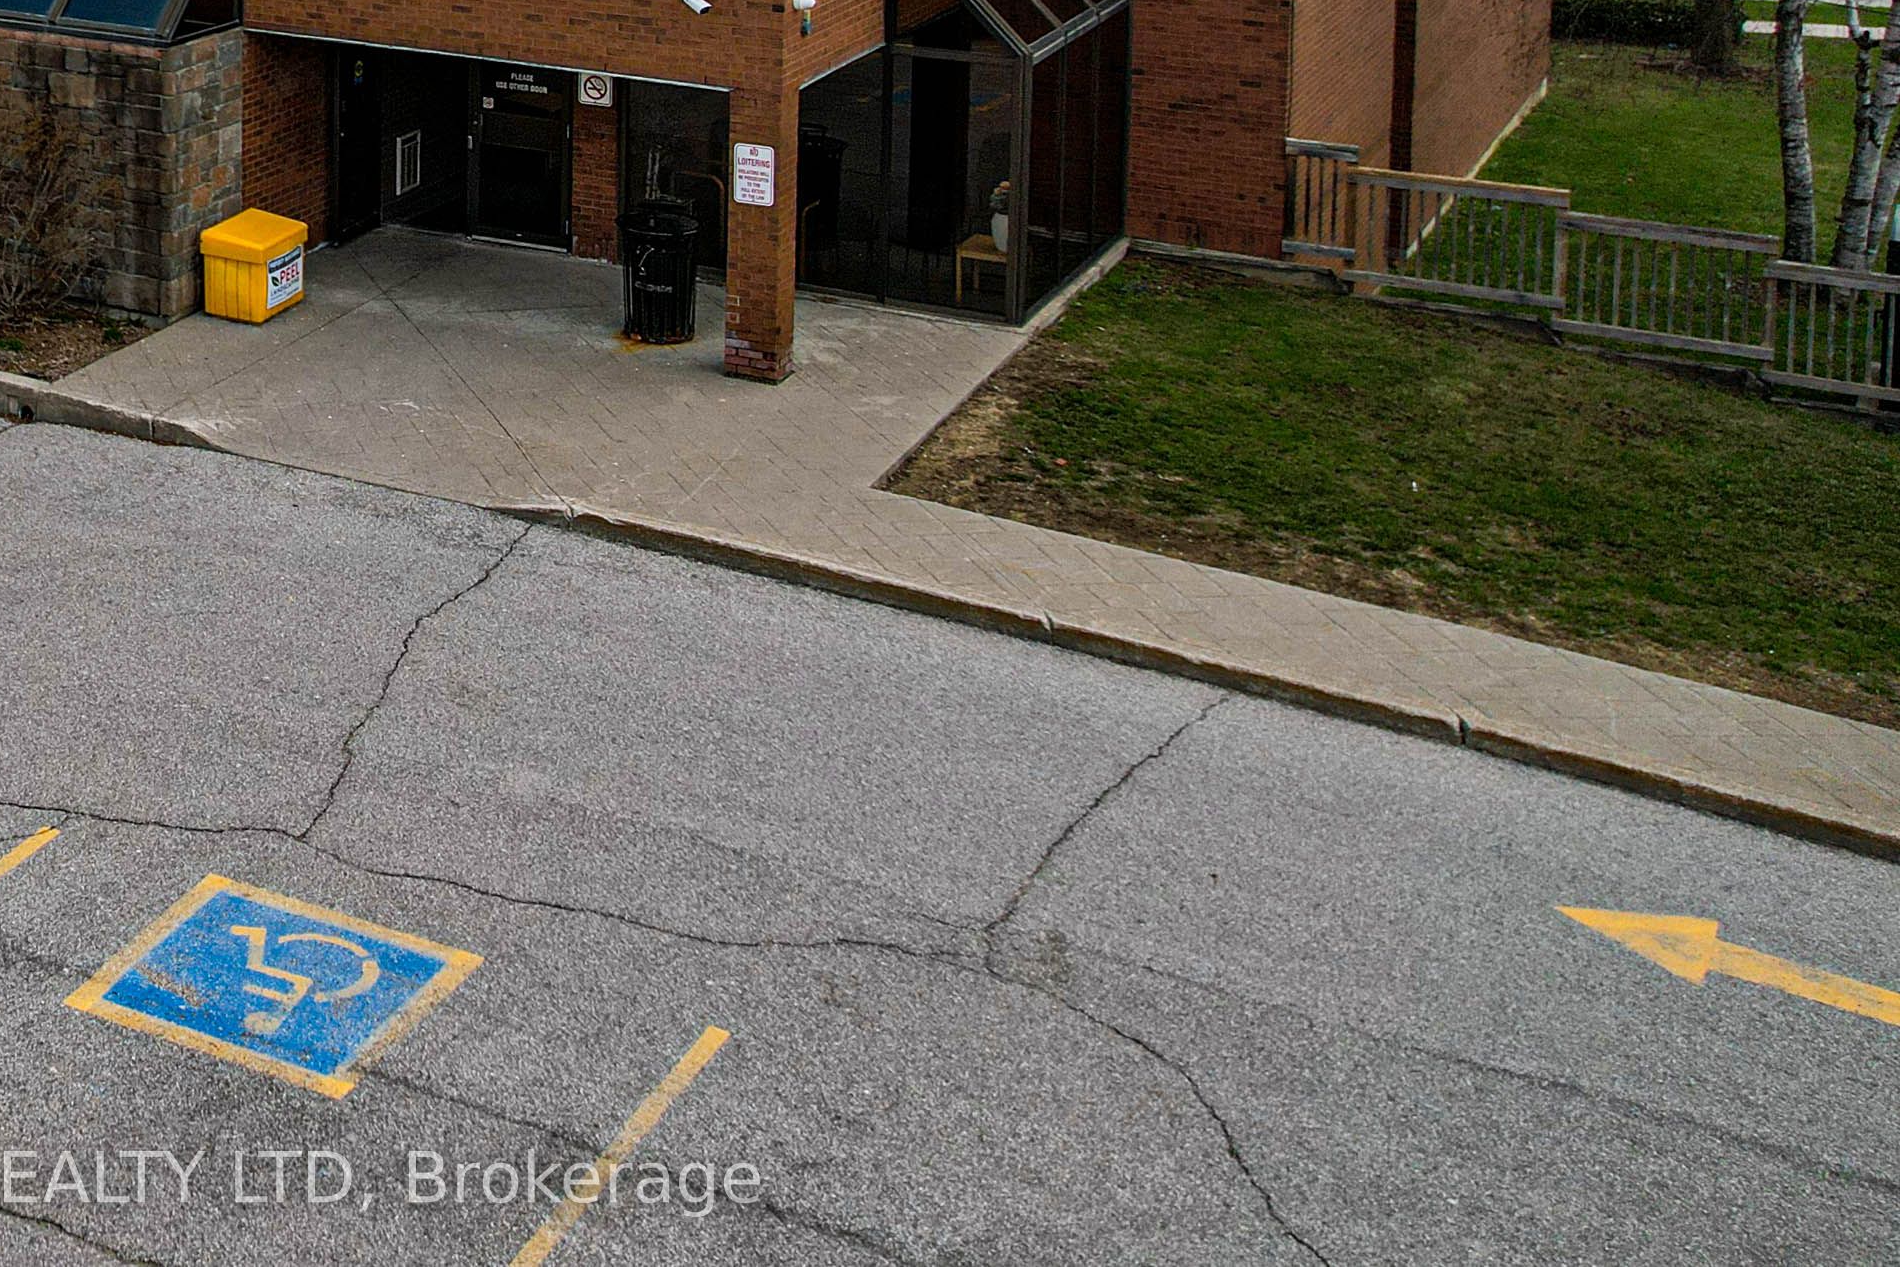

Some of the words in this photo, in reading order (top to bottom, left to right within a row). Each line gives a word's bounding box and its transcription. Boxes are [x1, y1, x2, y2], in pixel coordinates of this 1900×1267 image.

[510, 72, 534, 82] PLEASE
[738, 158, 770, 168] LOITERING
[280, 262, 300, 284] PEEL
